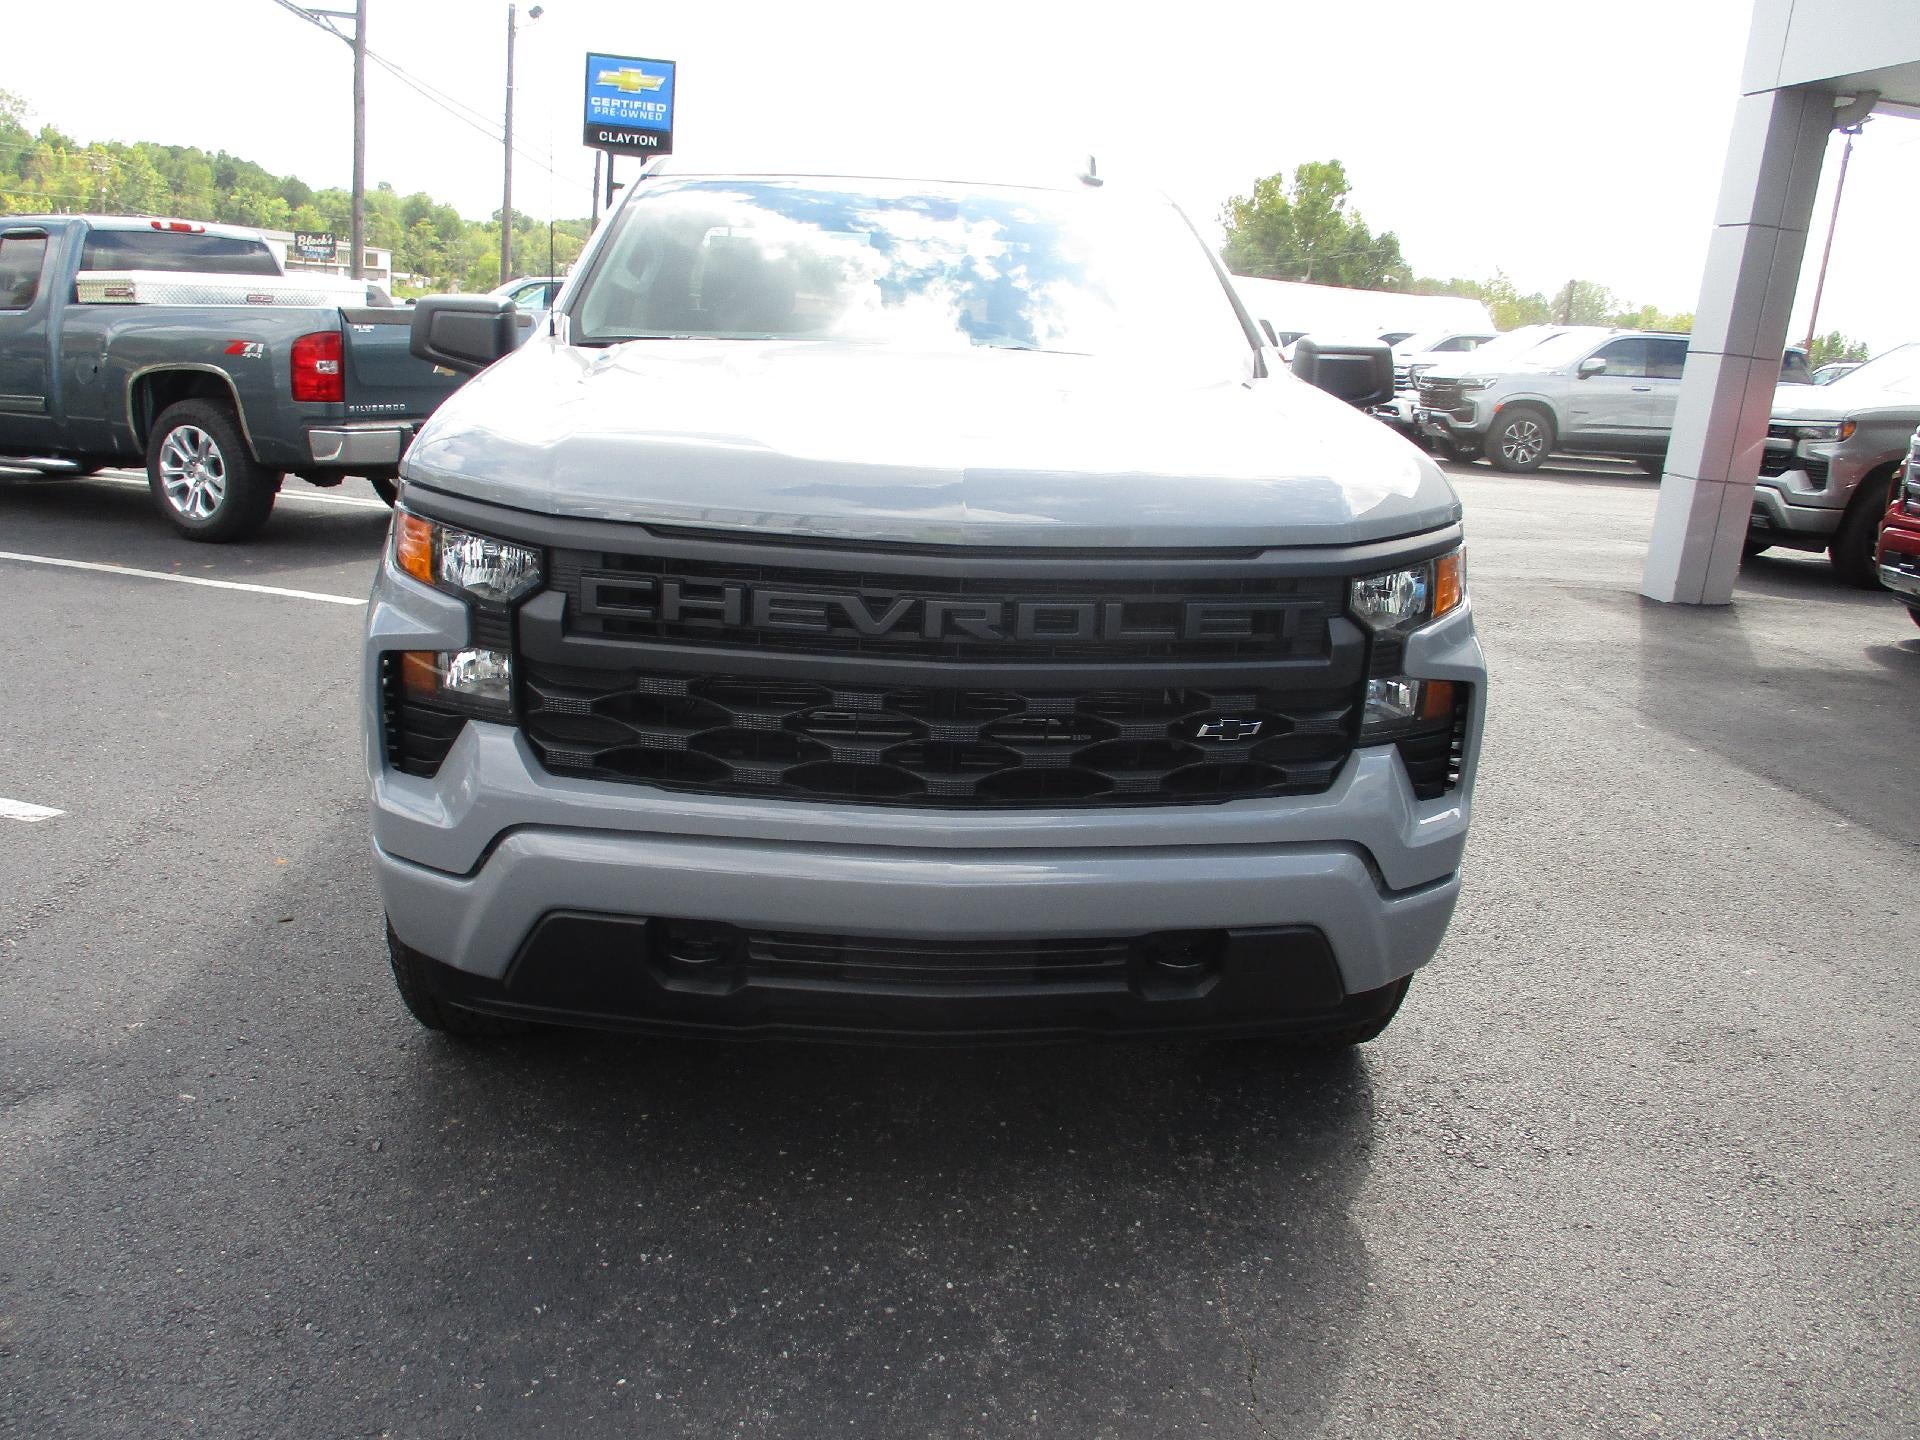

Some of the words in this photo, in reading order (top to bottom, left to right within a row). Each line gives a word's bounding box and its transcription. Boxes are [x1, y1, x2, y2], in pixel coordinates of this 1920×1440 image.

[590, 97, 667, 112] CERTIFIED
[594, 106, 663, 120] PRE-OWNED
[599, 131, 658, 146] CLAYTON
[224, 339, 264, 355] Z71
[579, 575, 1326, 641] CHEVROLET
